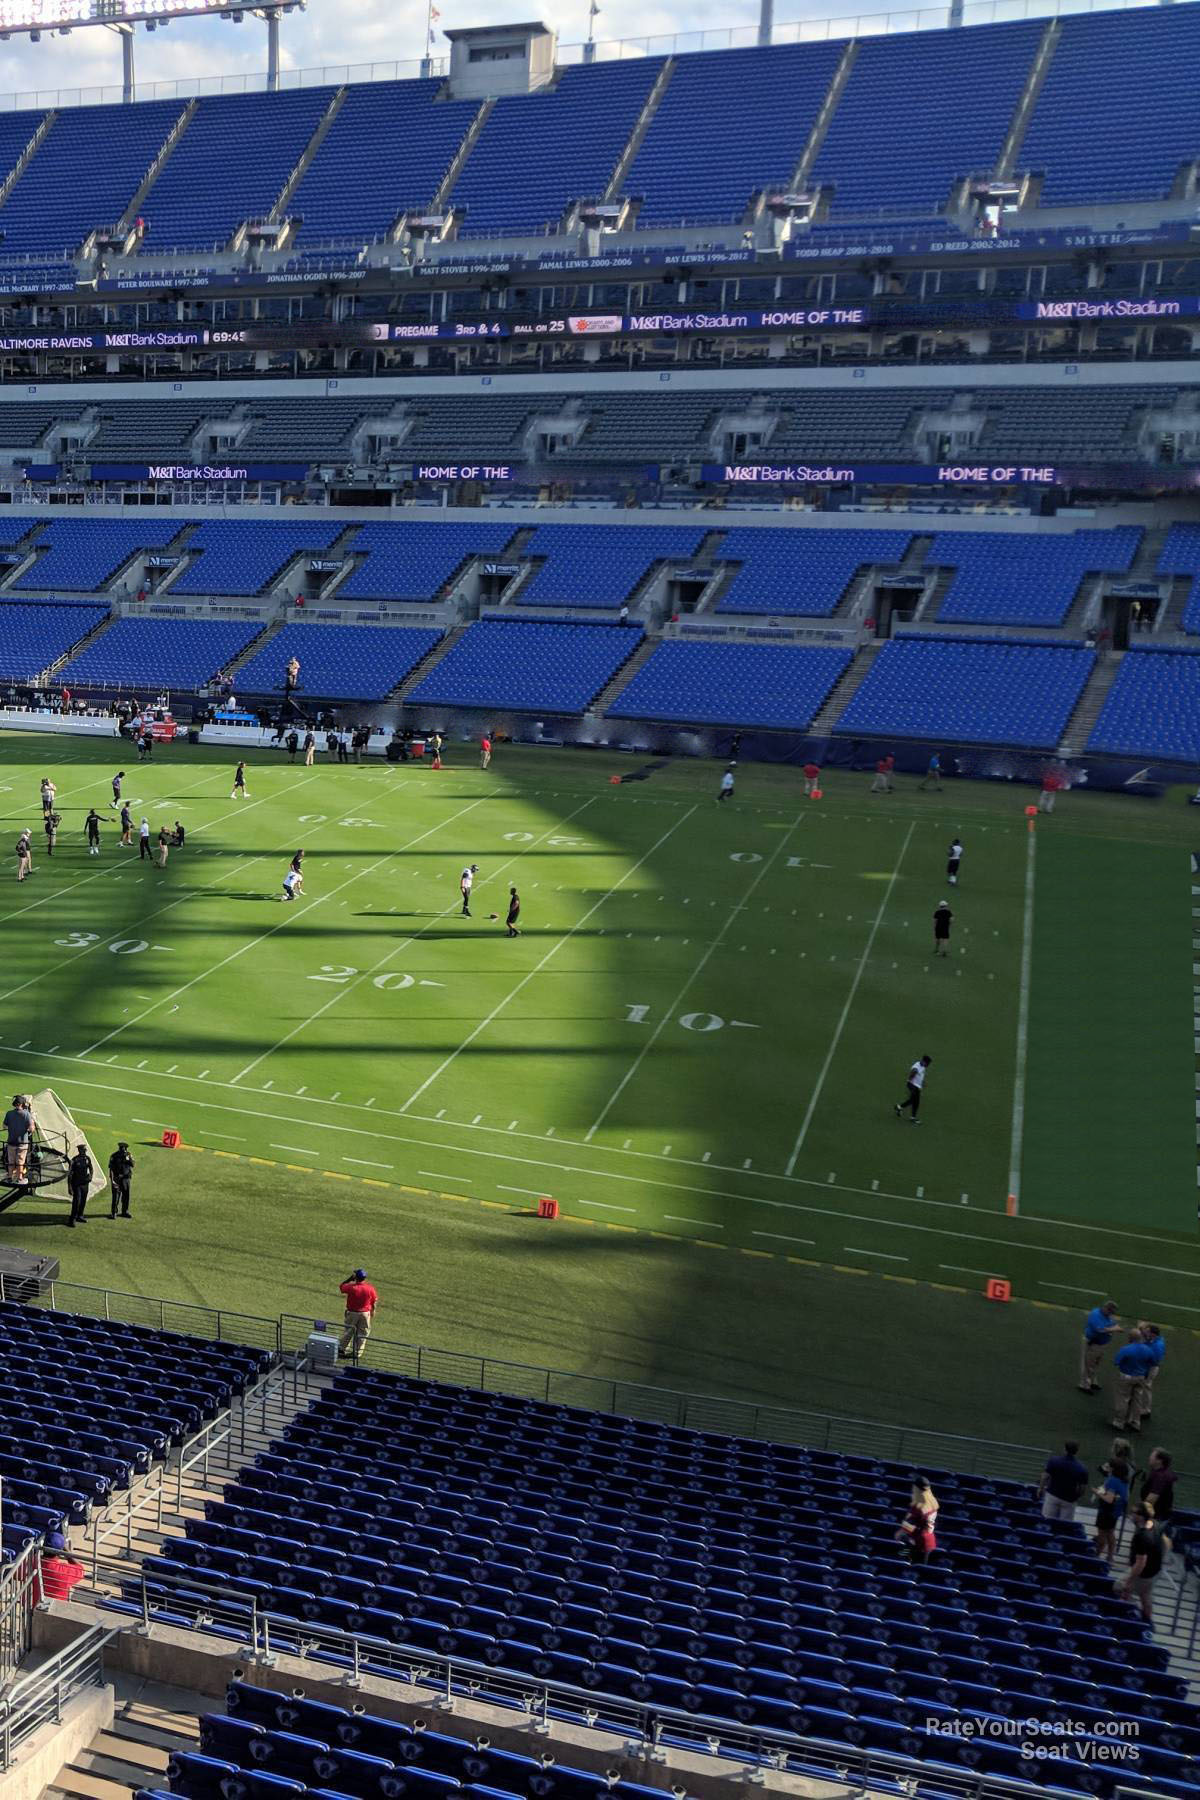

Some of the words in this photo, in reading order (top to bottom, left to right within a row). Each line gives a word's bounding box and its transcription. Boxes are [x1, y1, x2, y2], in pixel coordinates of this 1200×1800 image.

[945, 241, 968, 251] REED
[539, 261, 563, 270] JAMAL
[565, 260, 588, 270] LEWIS
[682, 254, 705, 263] LEWIS
[267, 274, 302, 283] JONATHAN
[303, 273, 328, 282] OGDEN
[330, 271, 366, 280] 1996-2007
[420, 266, 438, 276] MATT
[440, 265, 468, 274] STOVER
[138, 280, 172, 288] BOULWARE
[1036, 302, 1076, 318] M&T
[1077, 302, 1114, 317] Bank
[1116, 300, 1179, 316] Stadium
[630, 316, 662, 330] M&T
[663, 315, 694, 329] Bank
[695, 314, 748, 328] Stadium
[762, 312, 804, 325] HOME
[808, 311, 829, 324] OF
[833, 310, 862, 324] THE
[395, 326, 438, 336] PREGAME
[514, 324, 532, 333] BALL
[536, 324, 547, 332] ON
[550, 320, 565, 332] 25
[52, 337, 93, 348] RAVENS
[105, 334, 130, 346] M&T
[132, 334, 156, 345] Bank
[157, 332, 198, 344] Stadium
[148, 466, 175, 478] M&T
[176, 466, 202, 478] Bank
[204, 466, 247, 478] Stadium
[419, 467, 457, 479] HOME
[461, 467, 479, 479] OF
[482, 467, 509, 479] THE
[725, 466, 762, 480] M&T
[762, 467, 796, 480] Bank
[797, 467, 854, 481] Stadium
[939, 468, 988, 481] HOME
[992, 468, 1014, 481] OF
[1020, 469, 1054, 482] THE
[54, 932, 149, 955] 30
[306, 965, 415, 990] 20
[622, 1004, 725, 1032] 10
[163, 1132, 176, 1146] 20
[544, 1202, 554, 1216] 10
[992, 1282, 1006, 1298] G
